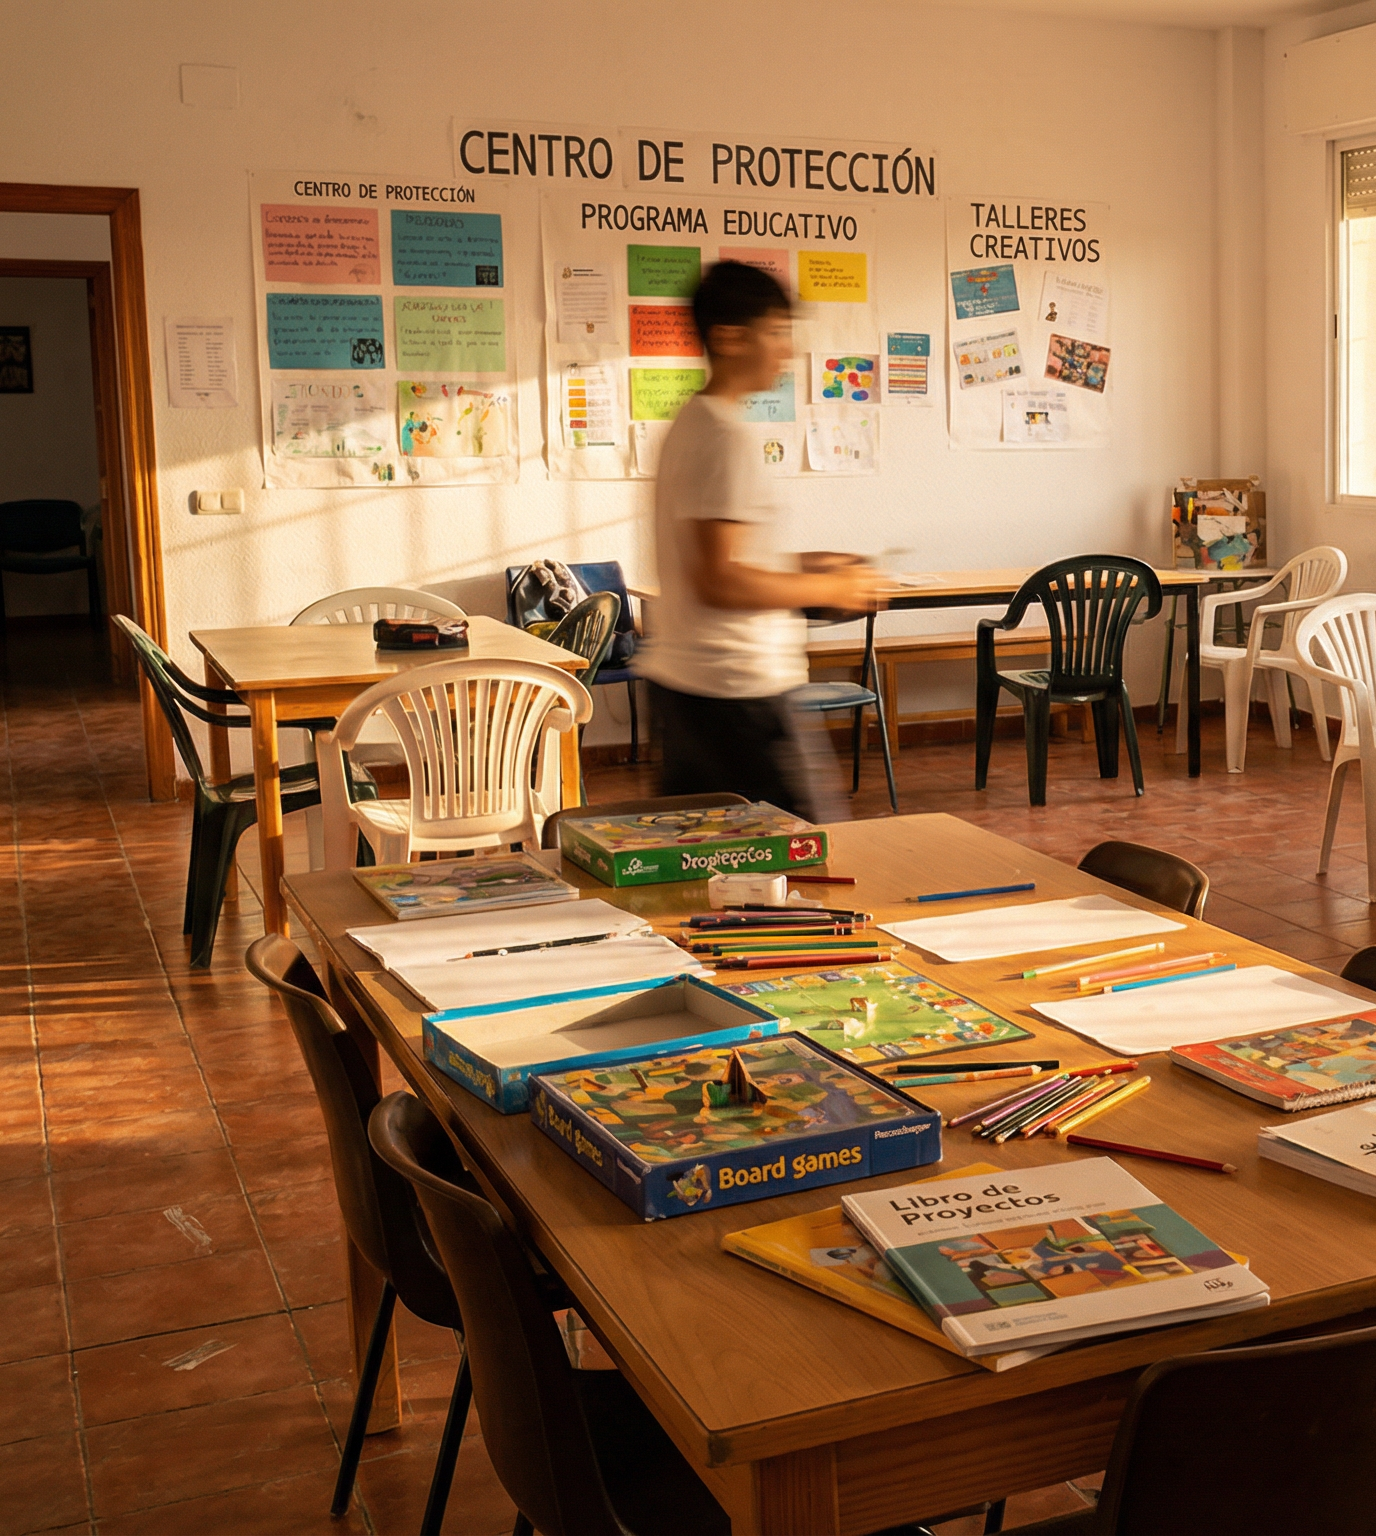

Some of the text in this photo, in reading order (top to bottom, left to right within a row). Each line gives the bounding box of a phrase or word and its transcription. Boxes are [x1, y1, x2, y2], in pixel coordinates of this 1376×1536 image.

[460, 130, 935, 195] CENTRO DE PROTECCIÓN
[294, 181, 476, 203] CENTRO DE PROTECCIÓN
[581, 203, 858, 241] PROGRAMA EDUCATIVO
[970, 203, 1087, 232] TALLERES
[970, 234, 1101, 263] CREATIVOS
[718, 1146, 863, 1190] Board games
[889, 1184, 1022, 1212] Libro de
[901, 1192, 1061, 1226] Proyectos
